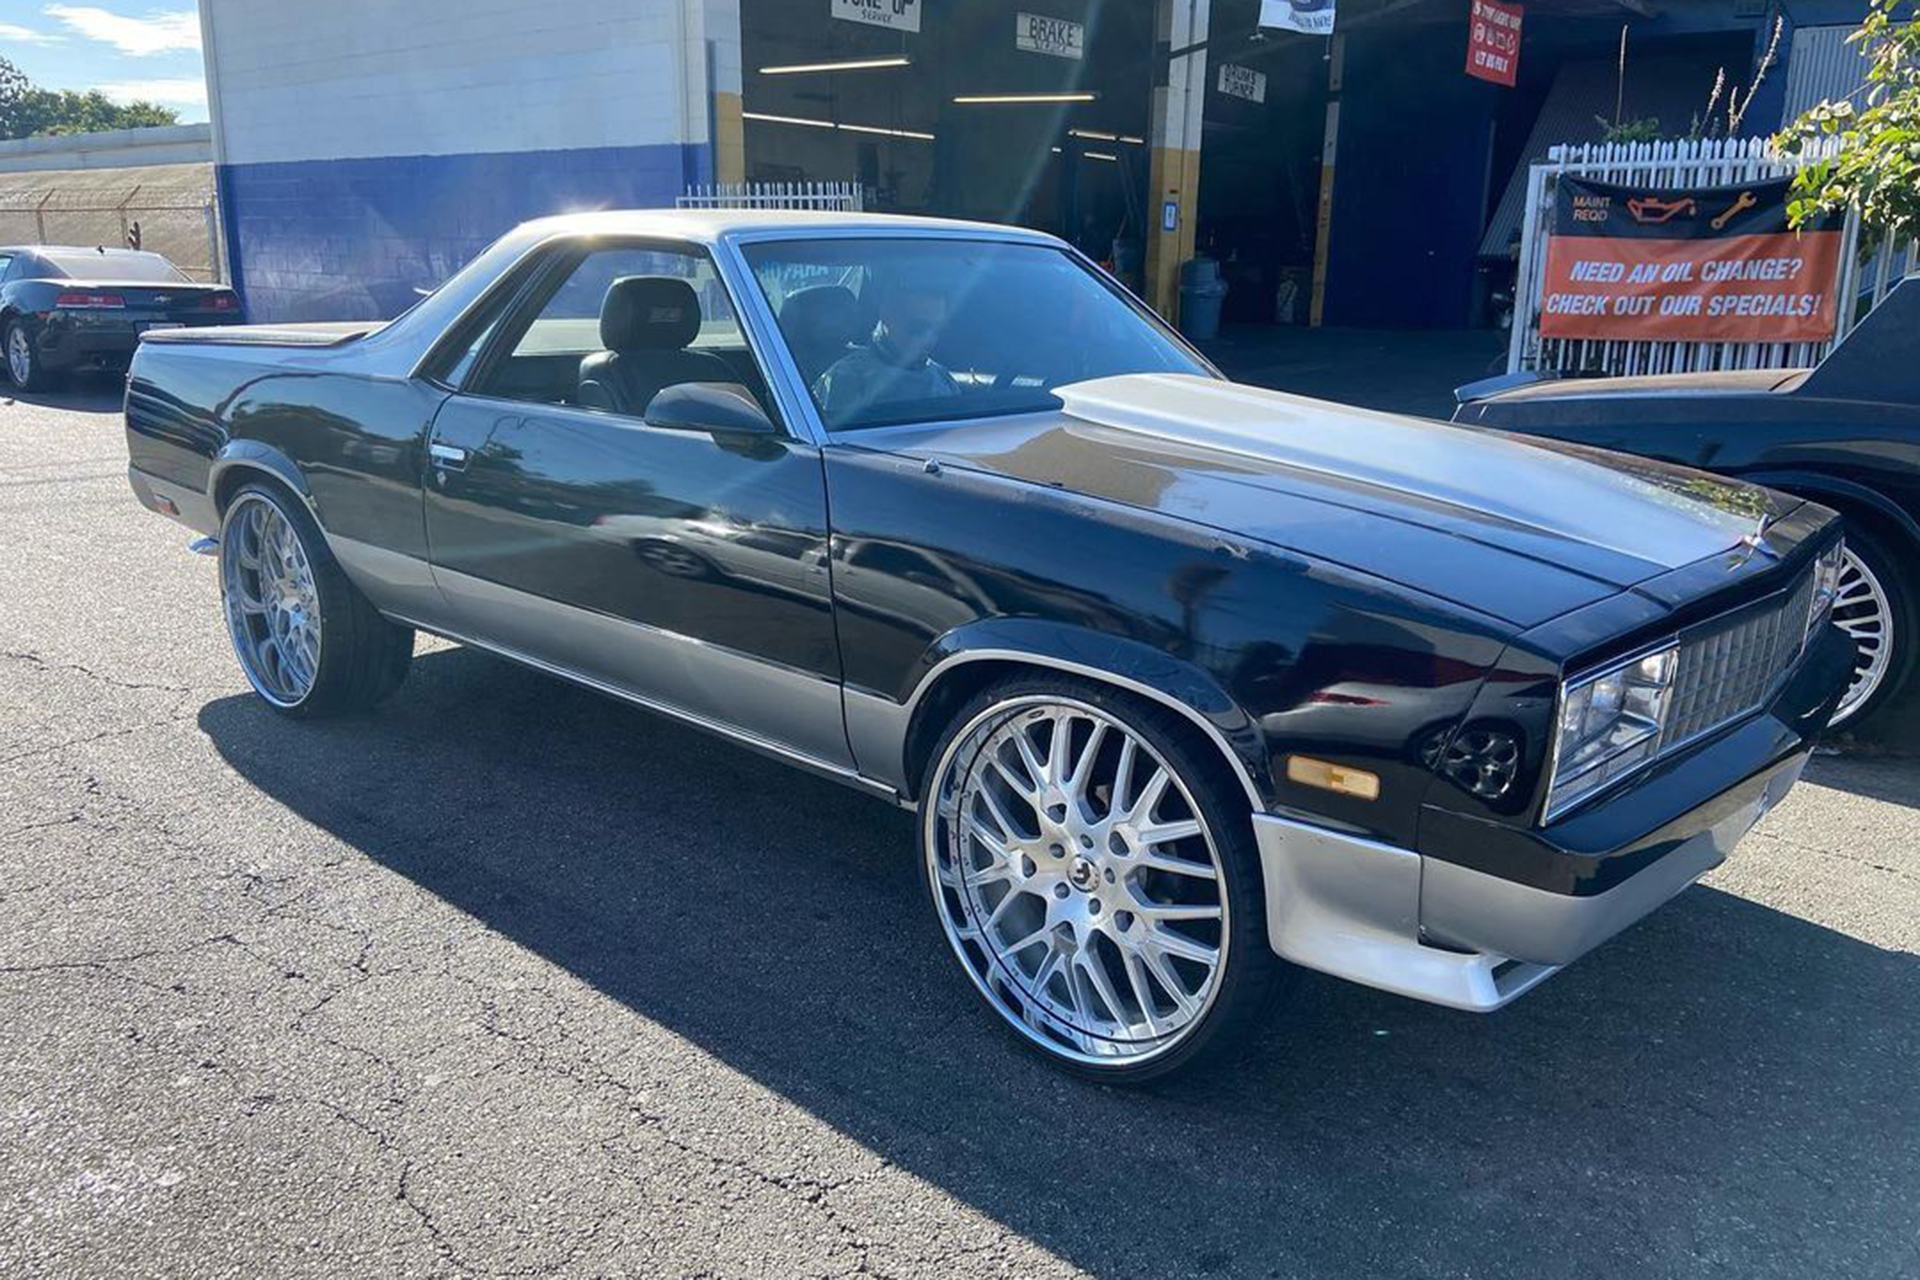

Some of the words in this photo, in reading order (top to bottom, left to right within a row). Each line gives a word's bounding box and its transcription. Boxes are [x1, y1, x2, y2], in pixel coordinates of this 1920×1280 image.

[1030, 17, 1074, 47] BRAKE
[1573, 196, 1612, 208] MAINT
[1573, 209, 1608, 221] REQD
[1569, 261, 1625, 283] NEED
[1626, 262, 1660, 284] AN
[1661, 262, 1694, 283] OIL
[1701, 258, 1803, 282] CHANGE?
[1546, 293, 1610, 315] CHECK
[1613, 295, 1655, 316] OUT
[1659, 295, 1703, 316] OUR
[1707, 293, 1821, 316] SPECIALS!
